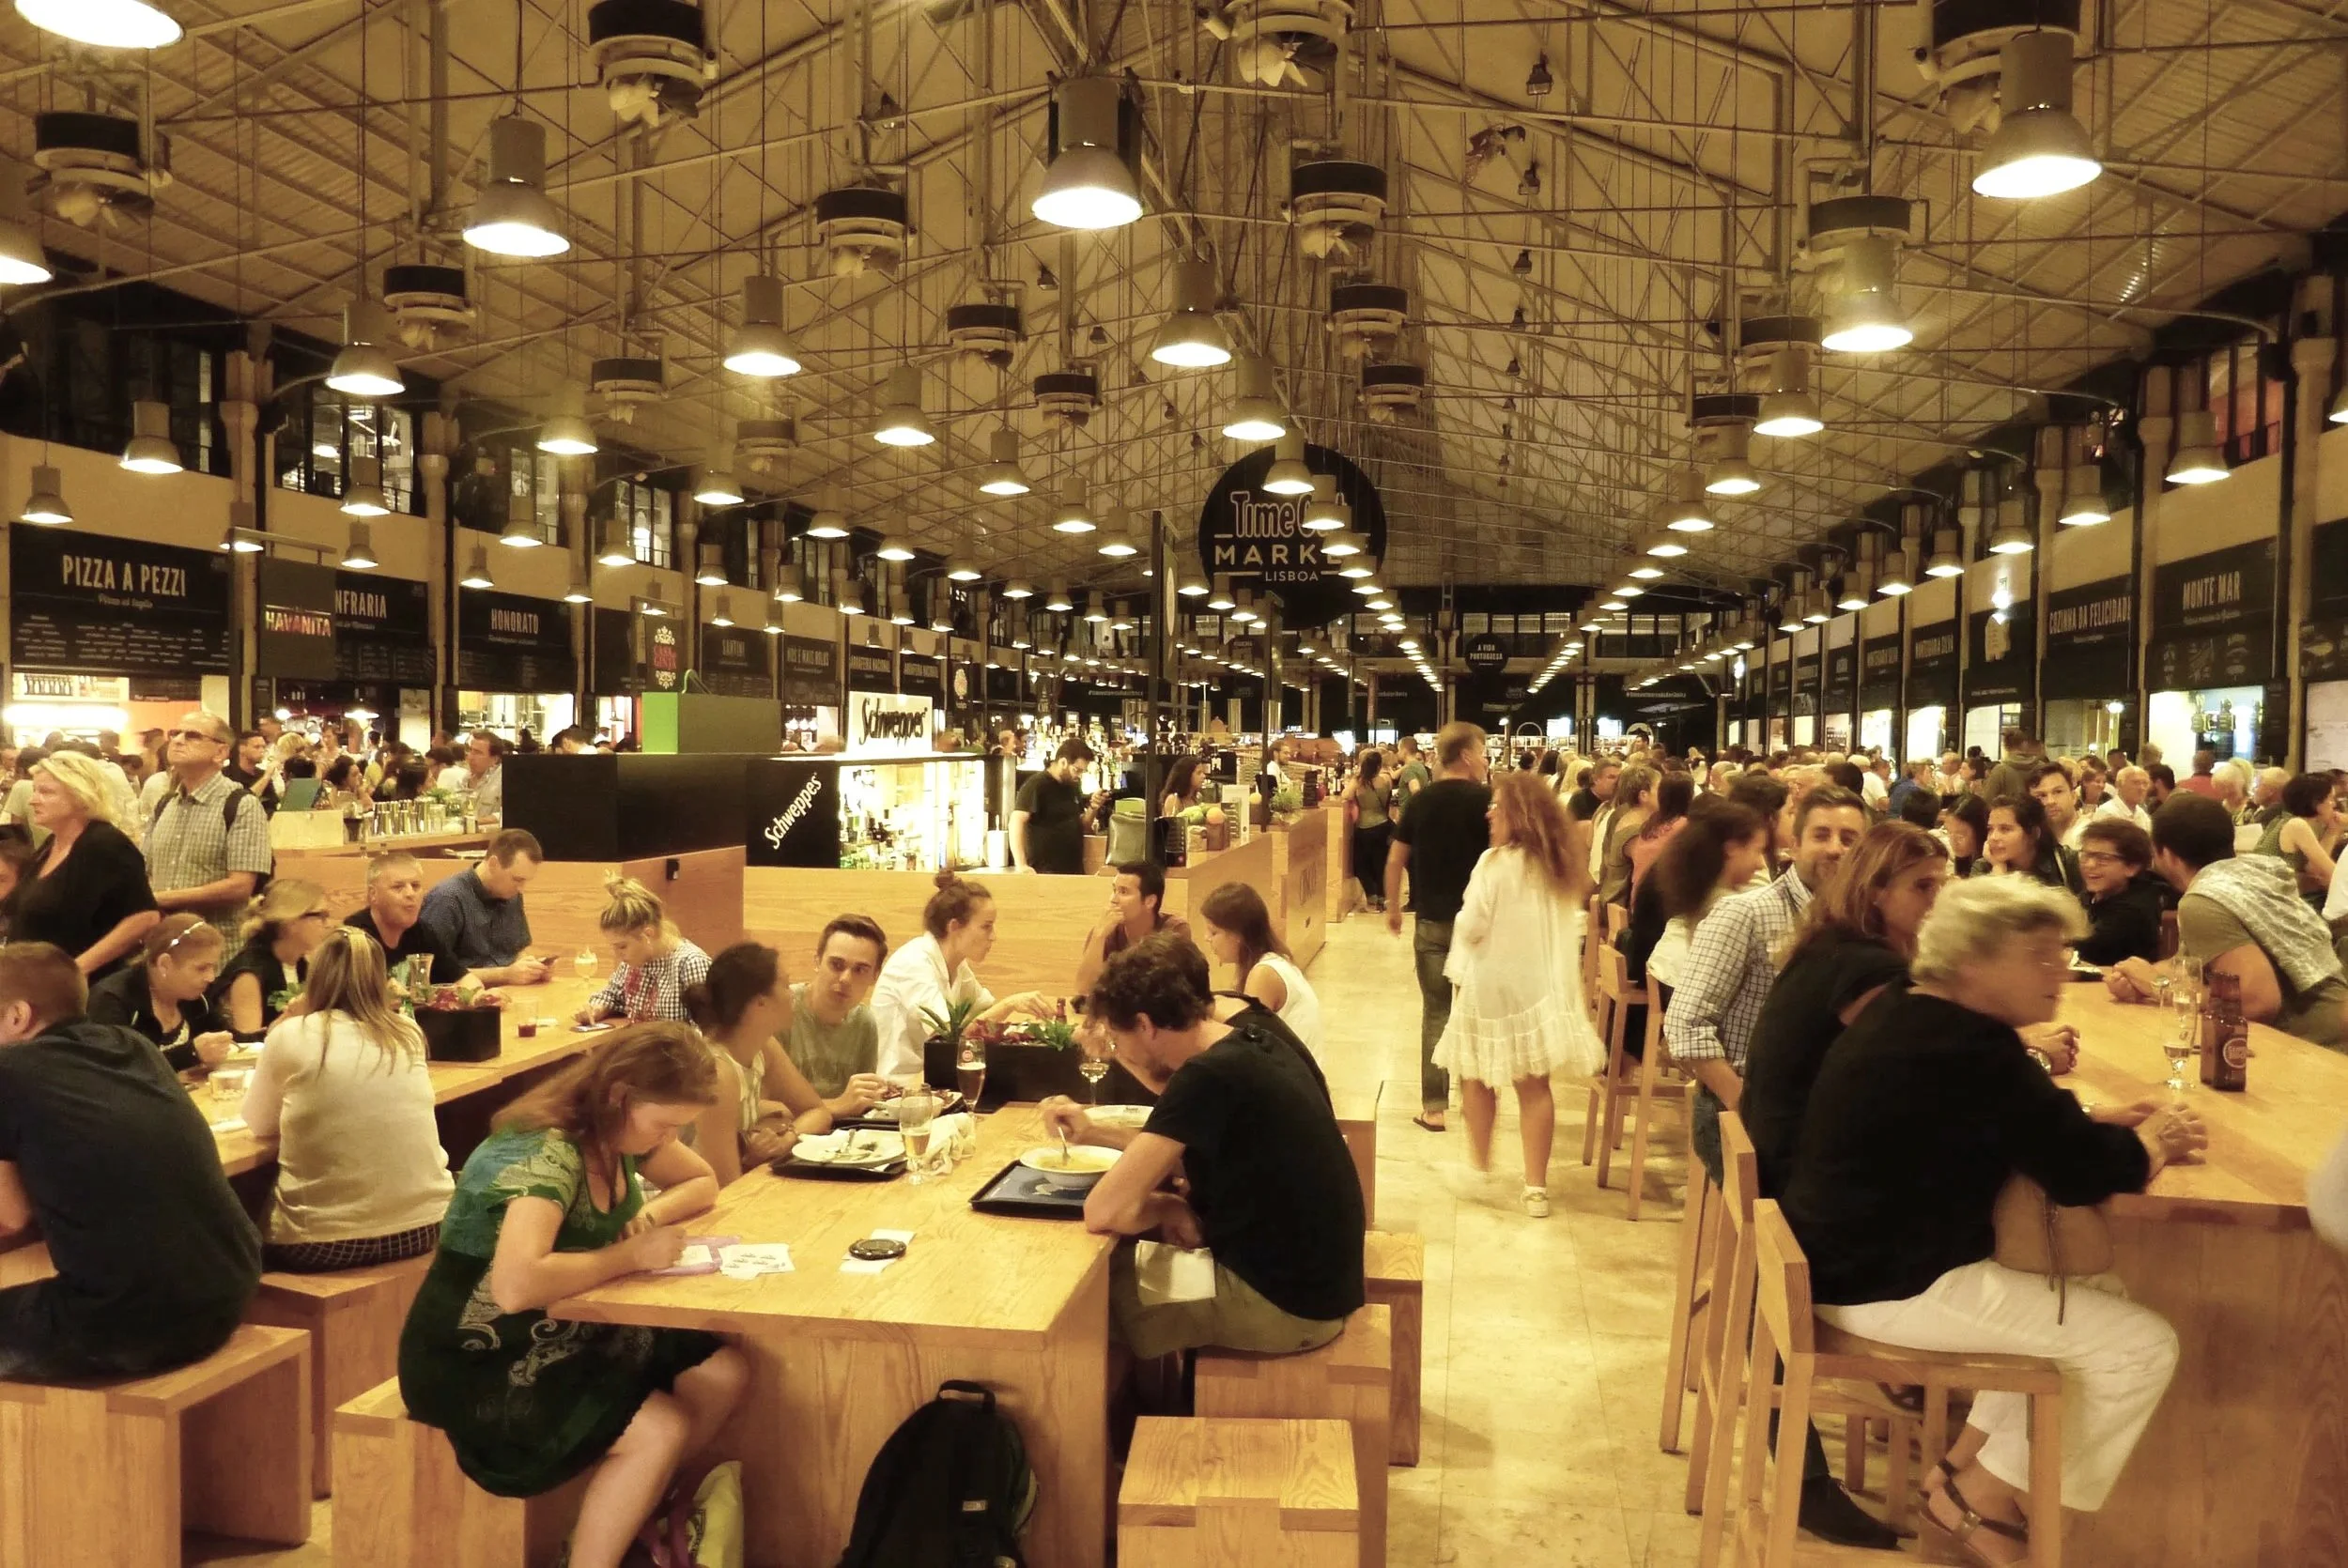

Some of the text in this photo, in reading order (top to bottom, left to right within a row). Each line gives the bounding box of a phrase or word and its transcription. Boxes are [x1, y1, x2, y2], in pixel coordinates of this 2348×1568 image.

[1230, 491, 1295, 538] Time
[1214, 544, 1368, 565] MARK
[63, 554, 186, 597] PIZZA A PEZZI
[1265, 571, 1319, 582] LISBOA
[2183, 570, 2240, 610] MONTE MAR
[334, 590, 387, 619] NFRARIA
[265, 610, 332, 638] HAVANITA
[491, 607, 539, 635] HONORATO
[2049, 607, 2077, 635] COZINHA
[858, 698, 925, 747] Schweppes
[765, 776, 822, 850] Schweppes
